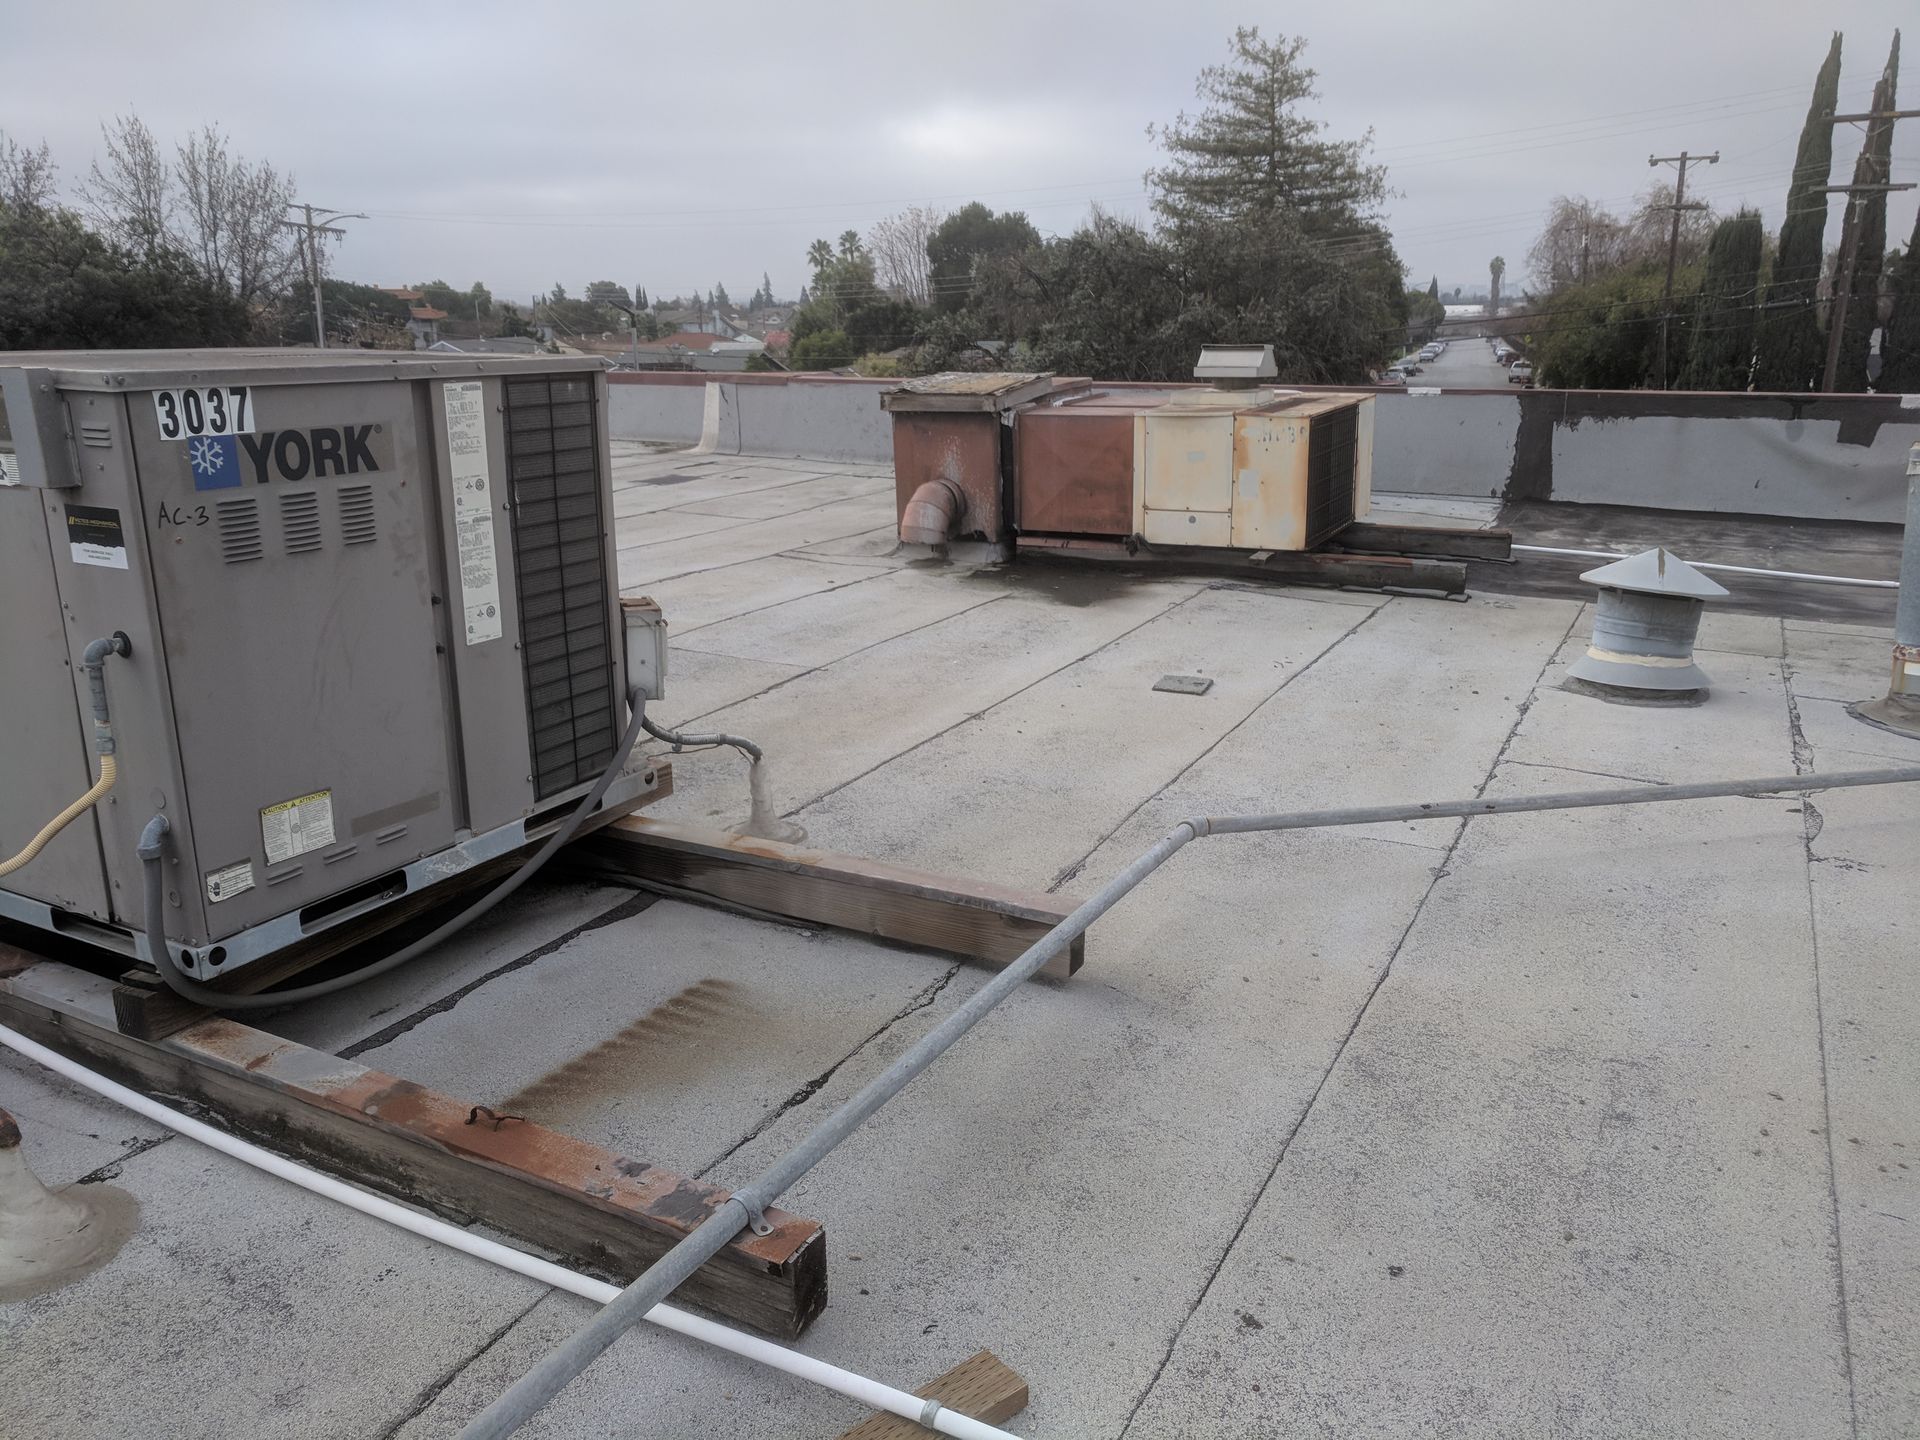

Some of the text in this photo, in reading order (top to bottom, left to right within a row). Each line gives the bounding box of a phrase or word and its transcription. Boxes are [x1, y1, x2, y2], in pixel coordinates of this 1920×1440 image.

[158, 387, 248, 438] 3037
[238, 424, 380, 484] YORK
[158, 501, 210, 529] AC-3
[263, 791, 327, 815] CAUTION ATTENTION
